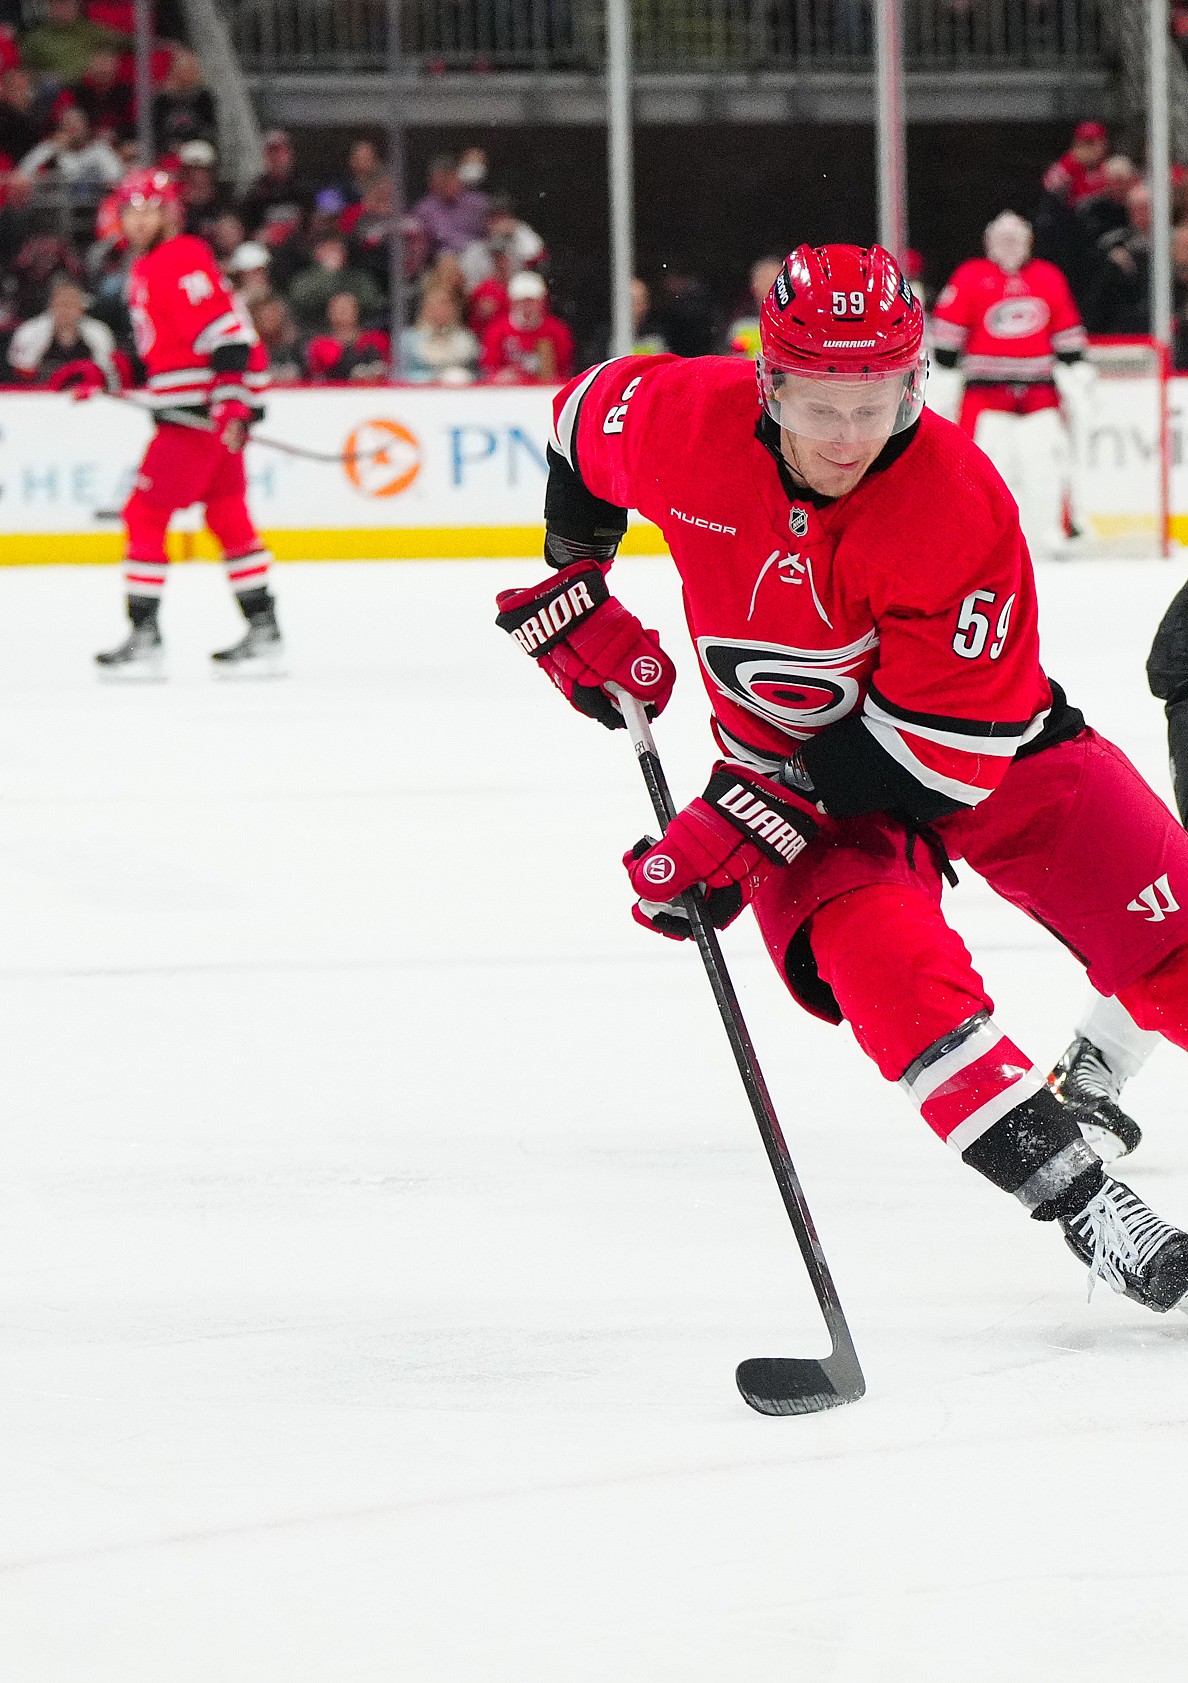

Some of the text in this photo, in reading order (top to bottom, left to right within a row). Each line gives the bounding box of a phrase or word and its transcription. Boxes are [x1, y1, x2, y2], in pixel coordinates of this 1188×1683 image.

[832, 291, 865, 316] 59
[822, 339, 876, 348] WARRIOR
[451, 426, 550, 486] PN
[670, 507, 737, 536] NUCOR
[510, 581, 594, 653] RRIOR
[952, 589, 1016, 660] 59
